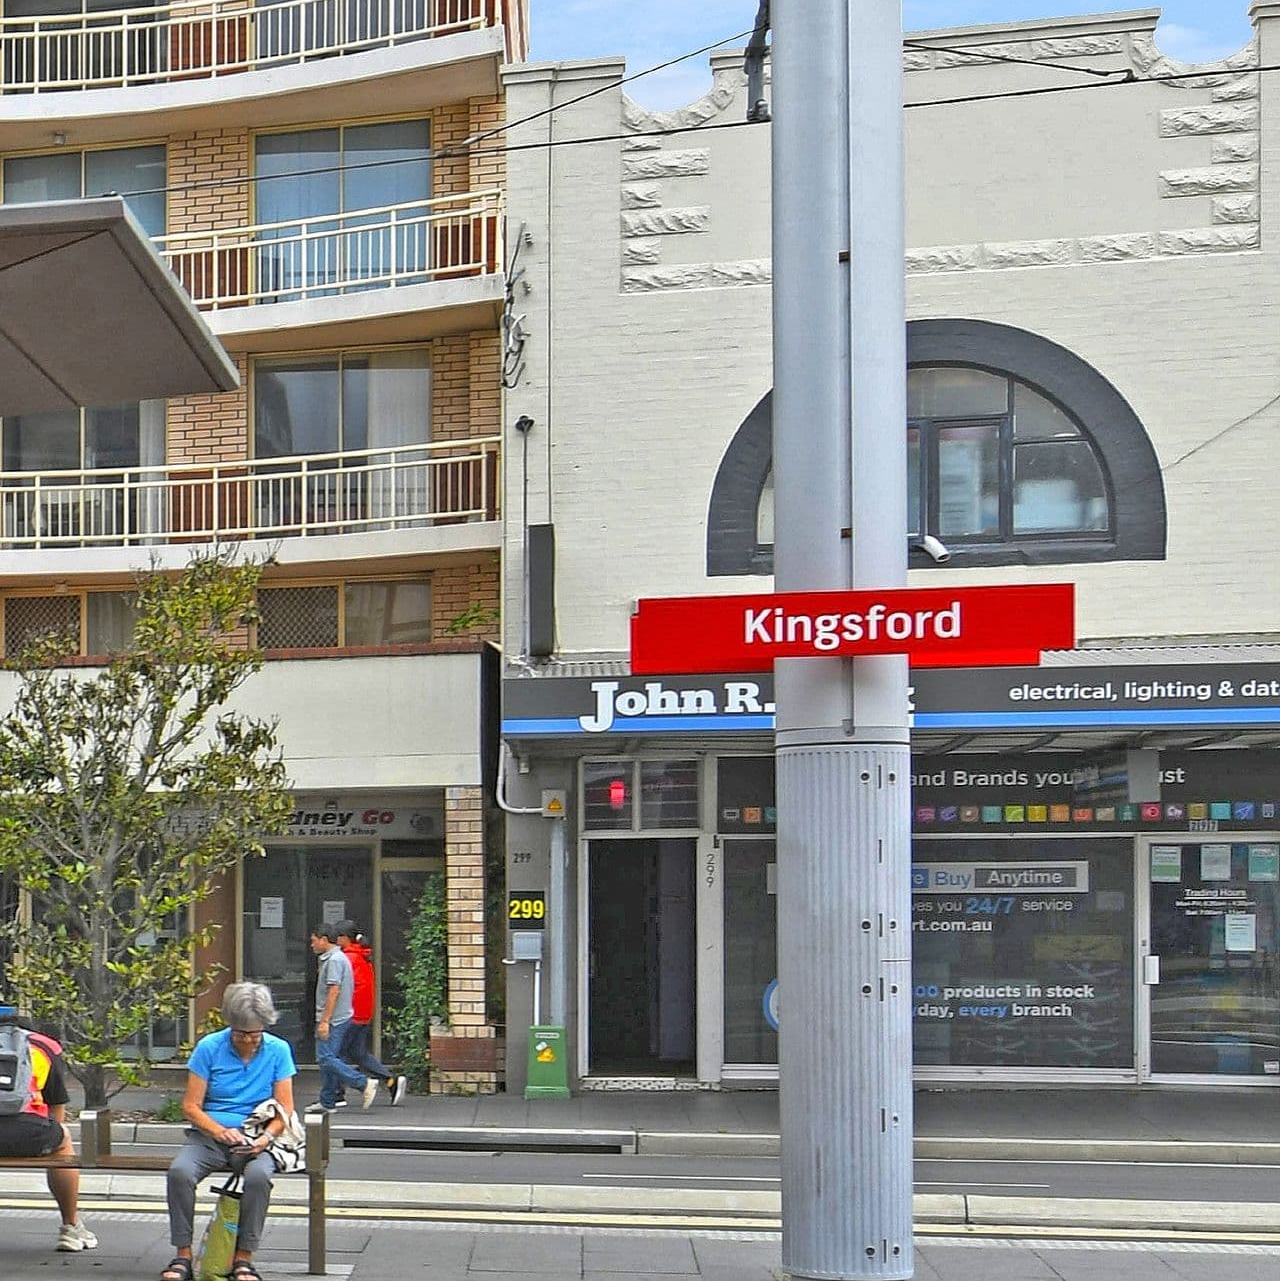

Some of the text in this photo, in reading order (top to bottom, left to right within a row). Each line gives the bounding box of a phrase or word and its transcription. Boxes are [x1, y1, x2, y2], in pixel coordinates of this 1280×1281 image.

[743, 601, 961, 651] Kingsford
[1008, 682, 1118, 702] electrical,
[1124, 680, 1212, 702] lighting
[1217, 680, 1235, 697] &
[579, 681, 717, 733] John
[952, 769, 1028, 787] Brands
[361, 809, 396, 826] Go
[309, 828, 348, 837] Beauty
[351, 827, 377, 837] Shop
[705, 853, 716, 889] 299
[935, 871, 972, 891] Buy
[986, 869, 1064, 888] Anytime
[507, 898, 545, 920] 299
[937, 900, 963, 914] you
[964, 897, 1016, 915] 24/7
[1021, 899, 1074, 912] service
[943, 984, 1021, 1000] products
[1025, 984, 1042, 998] in
[1046, 984, 1095, 998] stock
[958, 1004, 1009, 1018] every
[1011, 1002, 1073, 1017] branch
